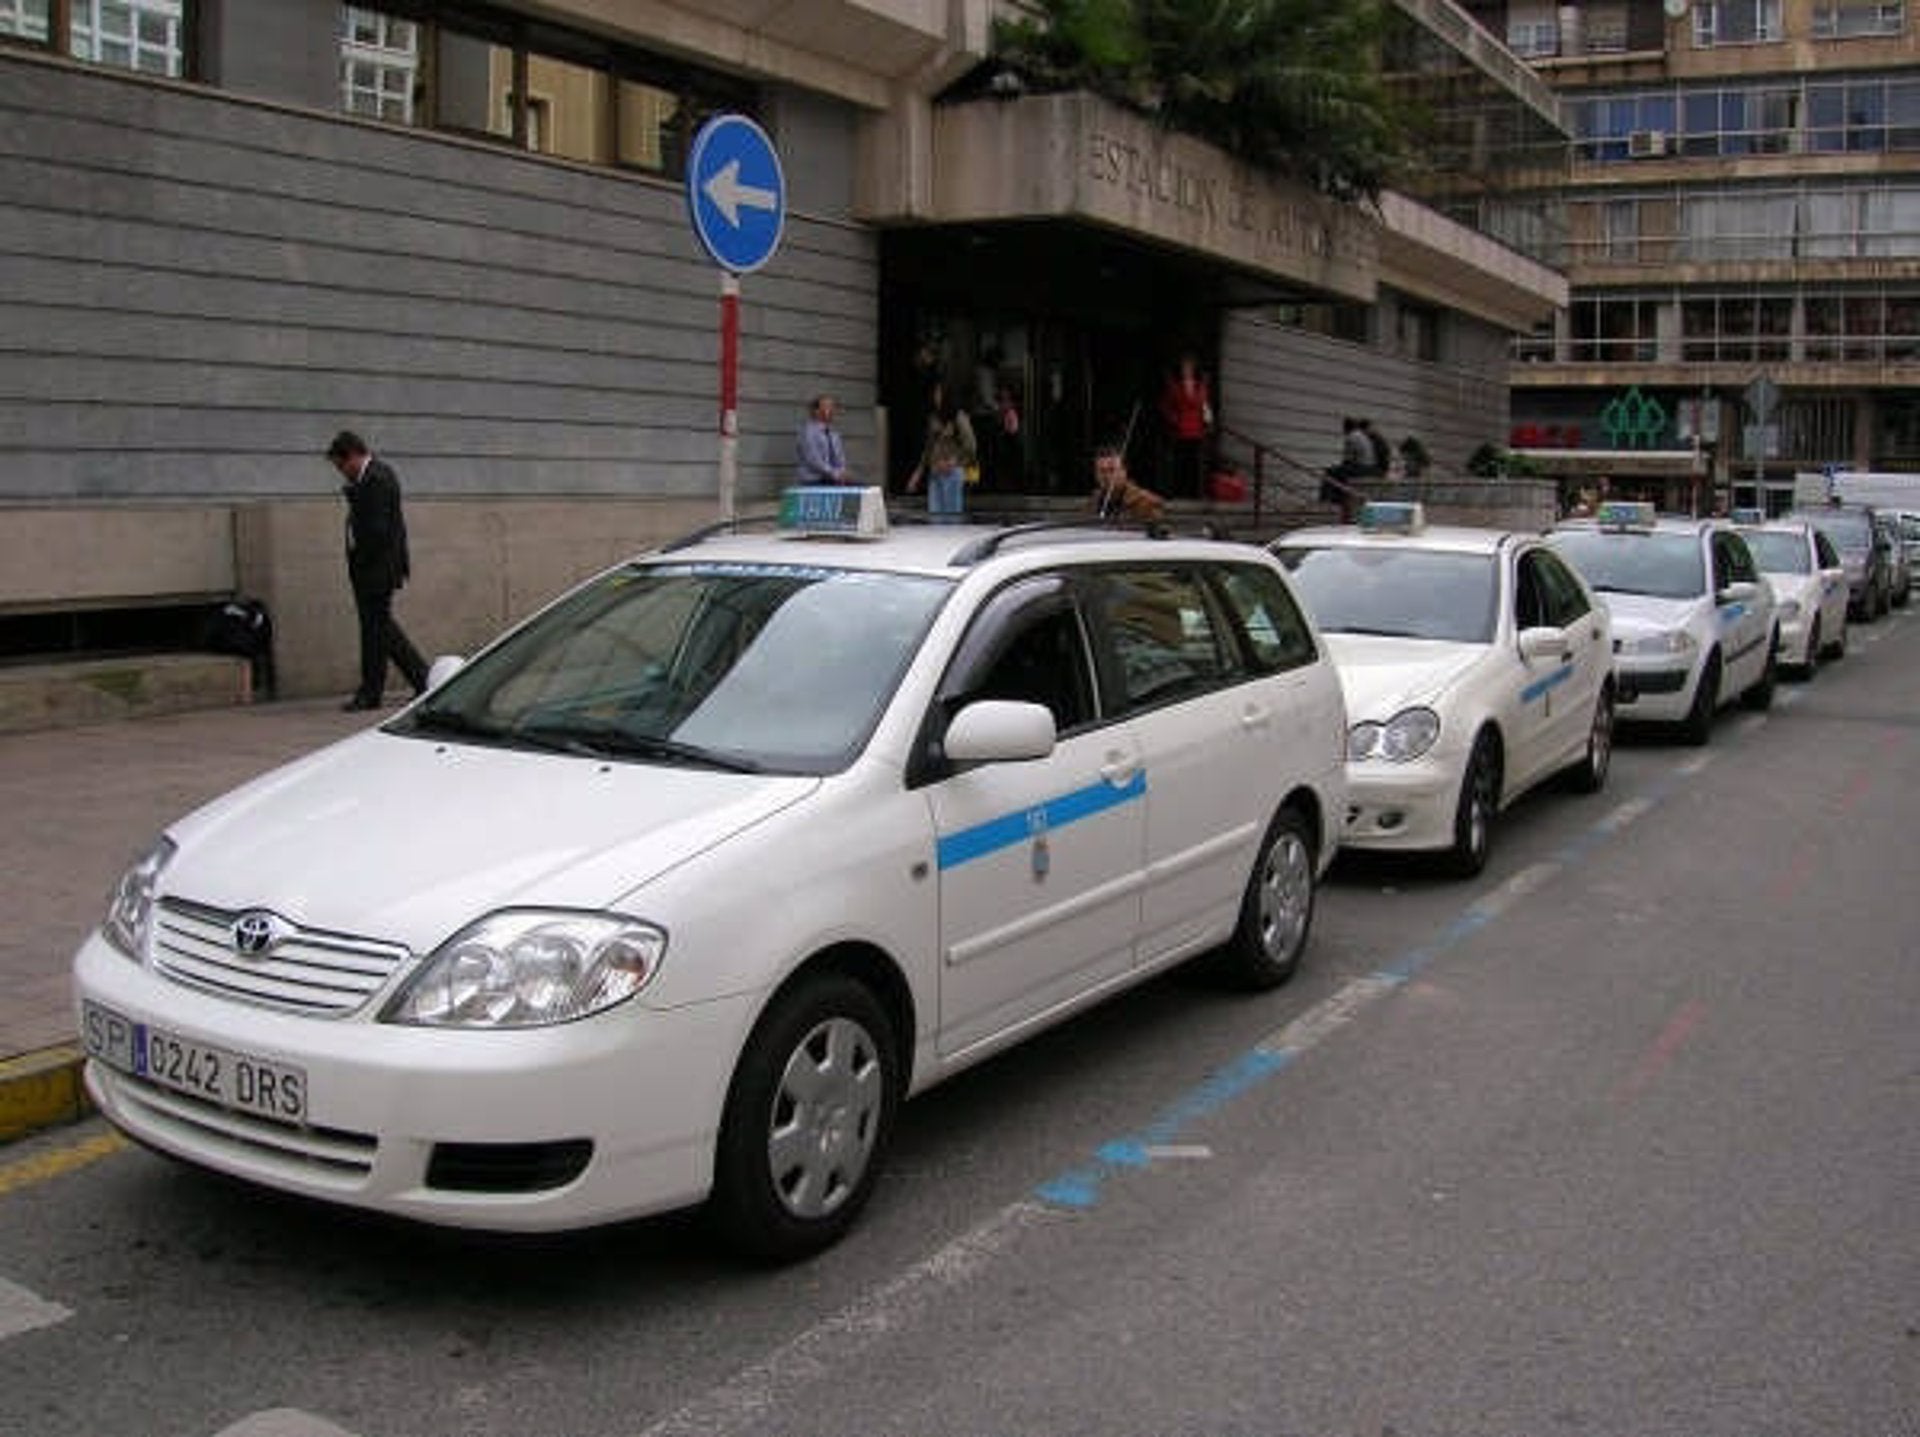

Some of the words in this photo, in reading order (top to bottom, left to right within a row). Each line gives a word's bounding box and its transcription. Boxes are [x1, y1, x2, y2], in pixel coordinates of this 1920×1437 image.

[88, 1010, 126, 1052] SP
[151, 1034, 221, 1095] 0242
[236, 1061, 300, 1116] DRS
